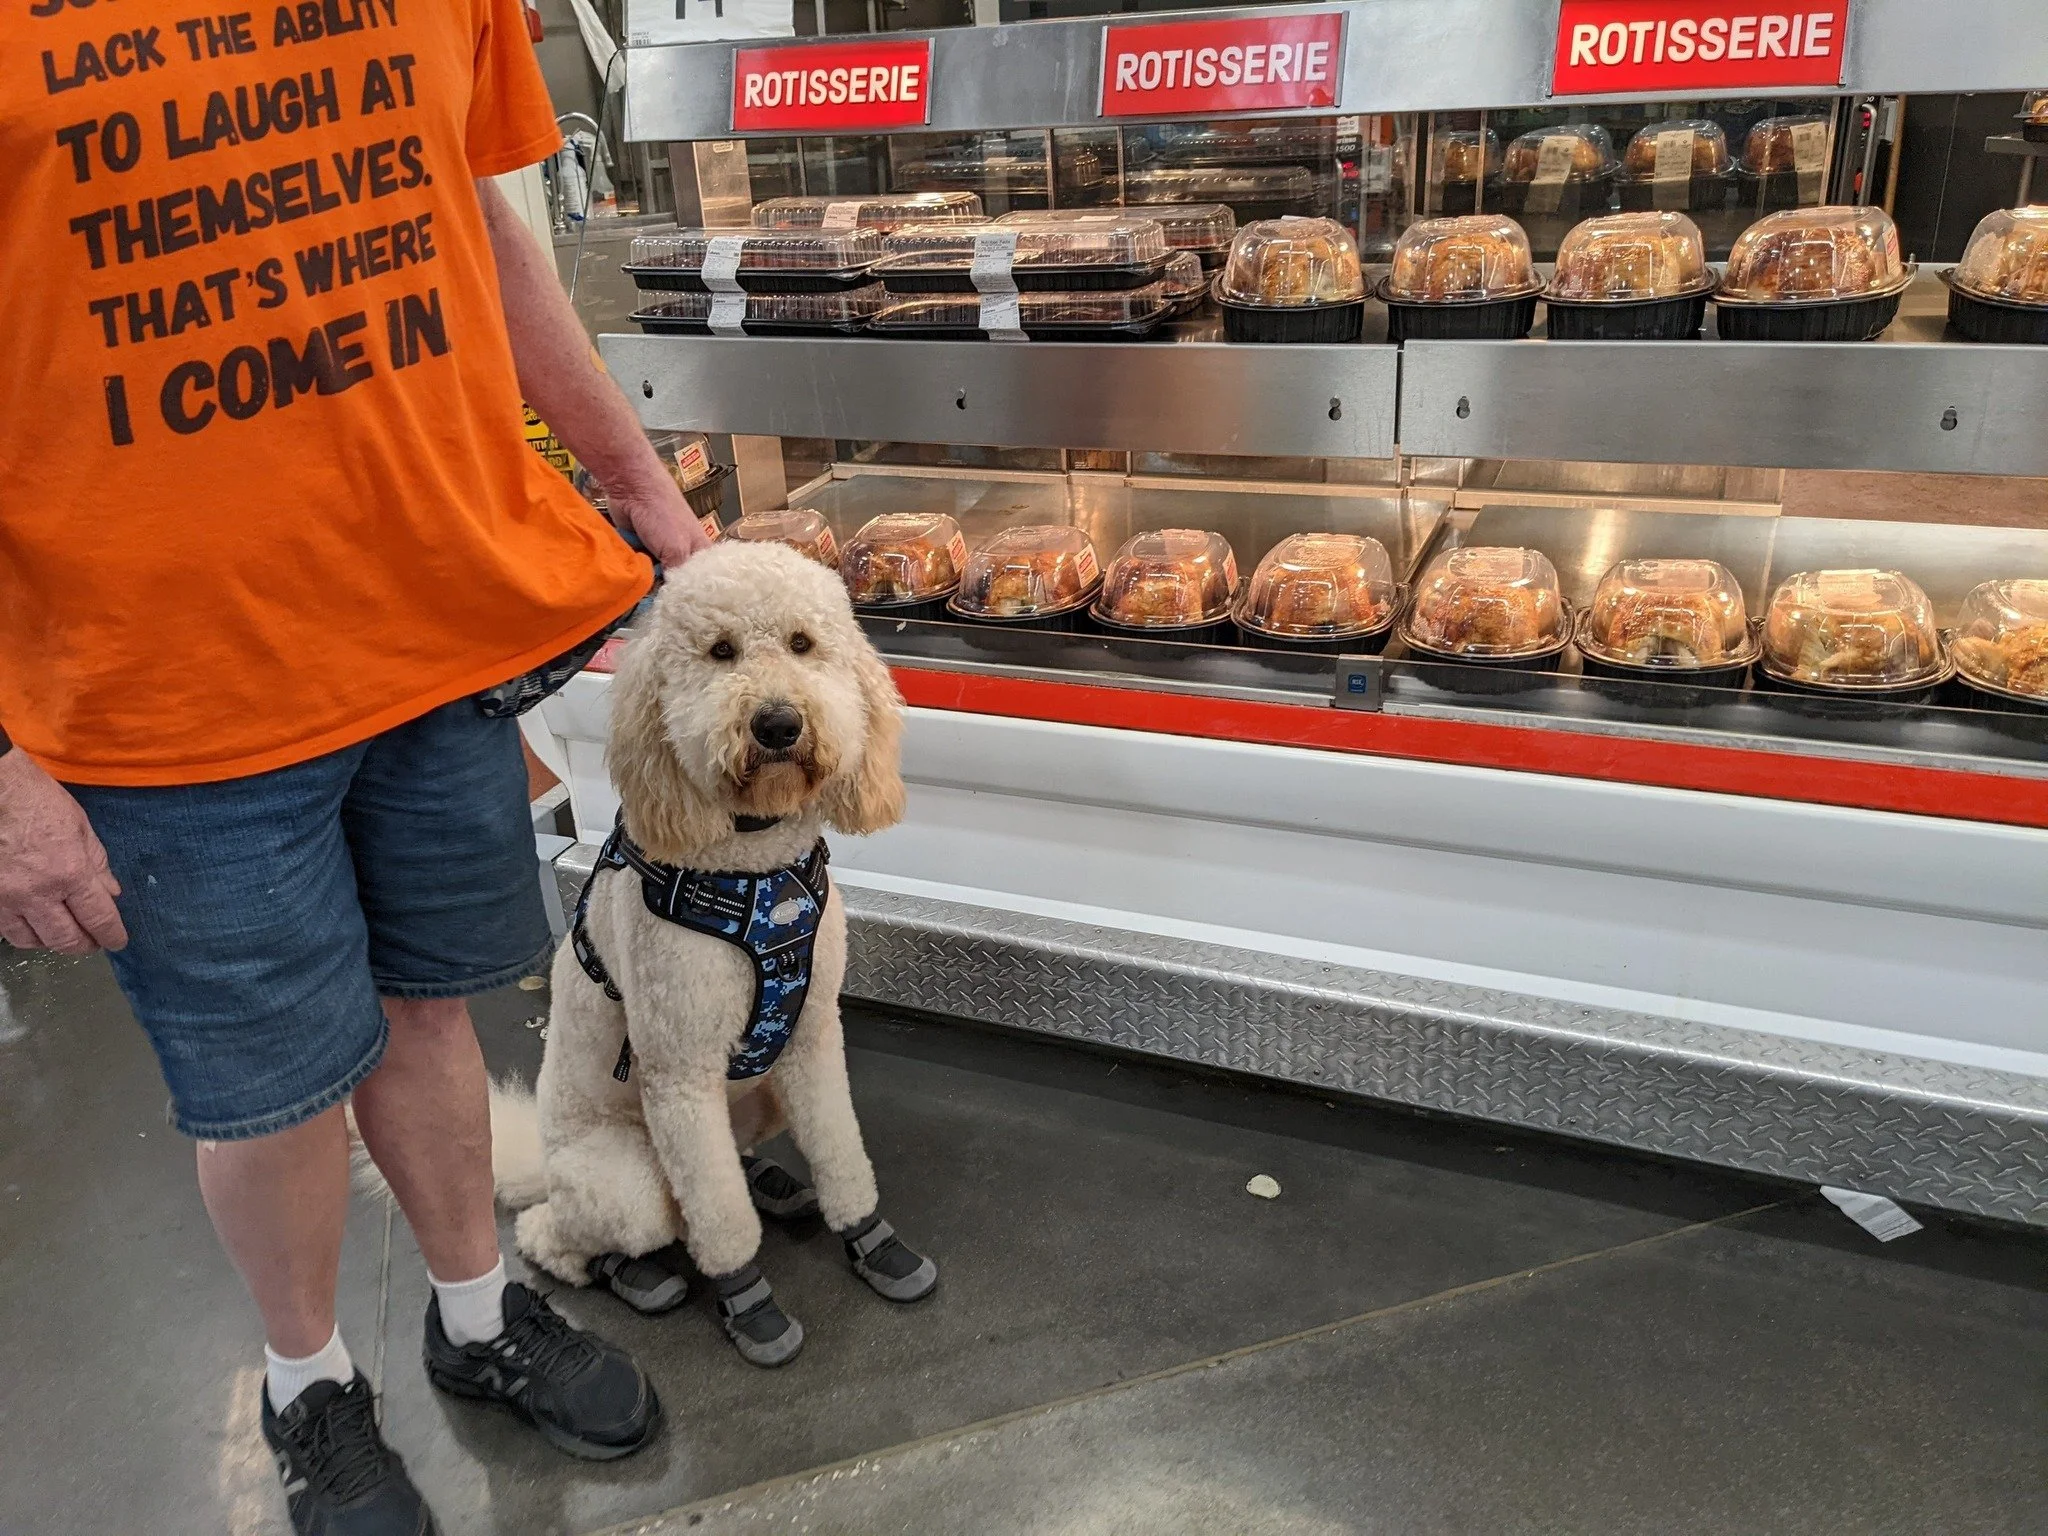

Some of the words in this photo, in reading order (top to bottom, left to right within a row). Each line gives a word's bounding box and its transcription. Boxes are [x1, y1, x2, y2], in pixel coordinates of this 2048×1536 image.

[42, 26, 166, 95] LACK
[176, 12, 257, 61] THE
[744, 65, 920, 109] ROTISSERIE
[1115, 41, 1330, 91] ROTISSERIE
[1570, 12, 1834, 66] ROTISSERIE
[57, 112, 141, 183] TO
[163, 67, 340, 160] LAUGH
[361, 54, 416, 115] AT
[69, 136, 433, 270] THEMSELVES.
[89, 258, 287, 348] THAT'S
[295, 212, 436, 297] WHERE
[104, 375, 135, 446] I
[160, 312, 374, 435] COME
[385, 288, 452, 371] IN
